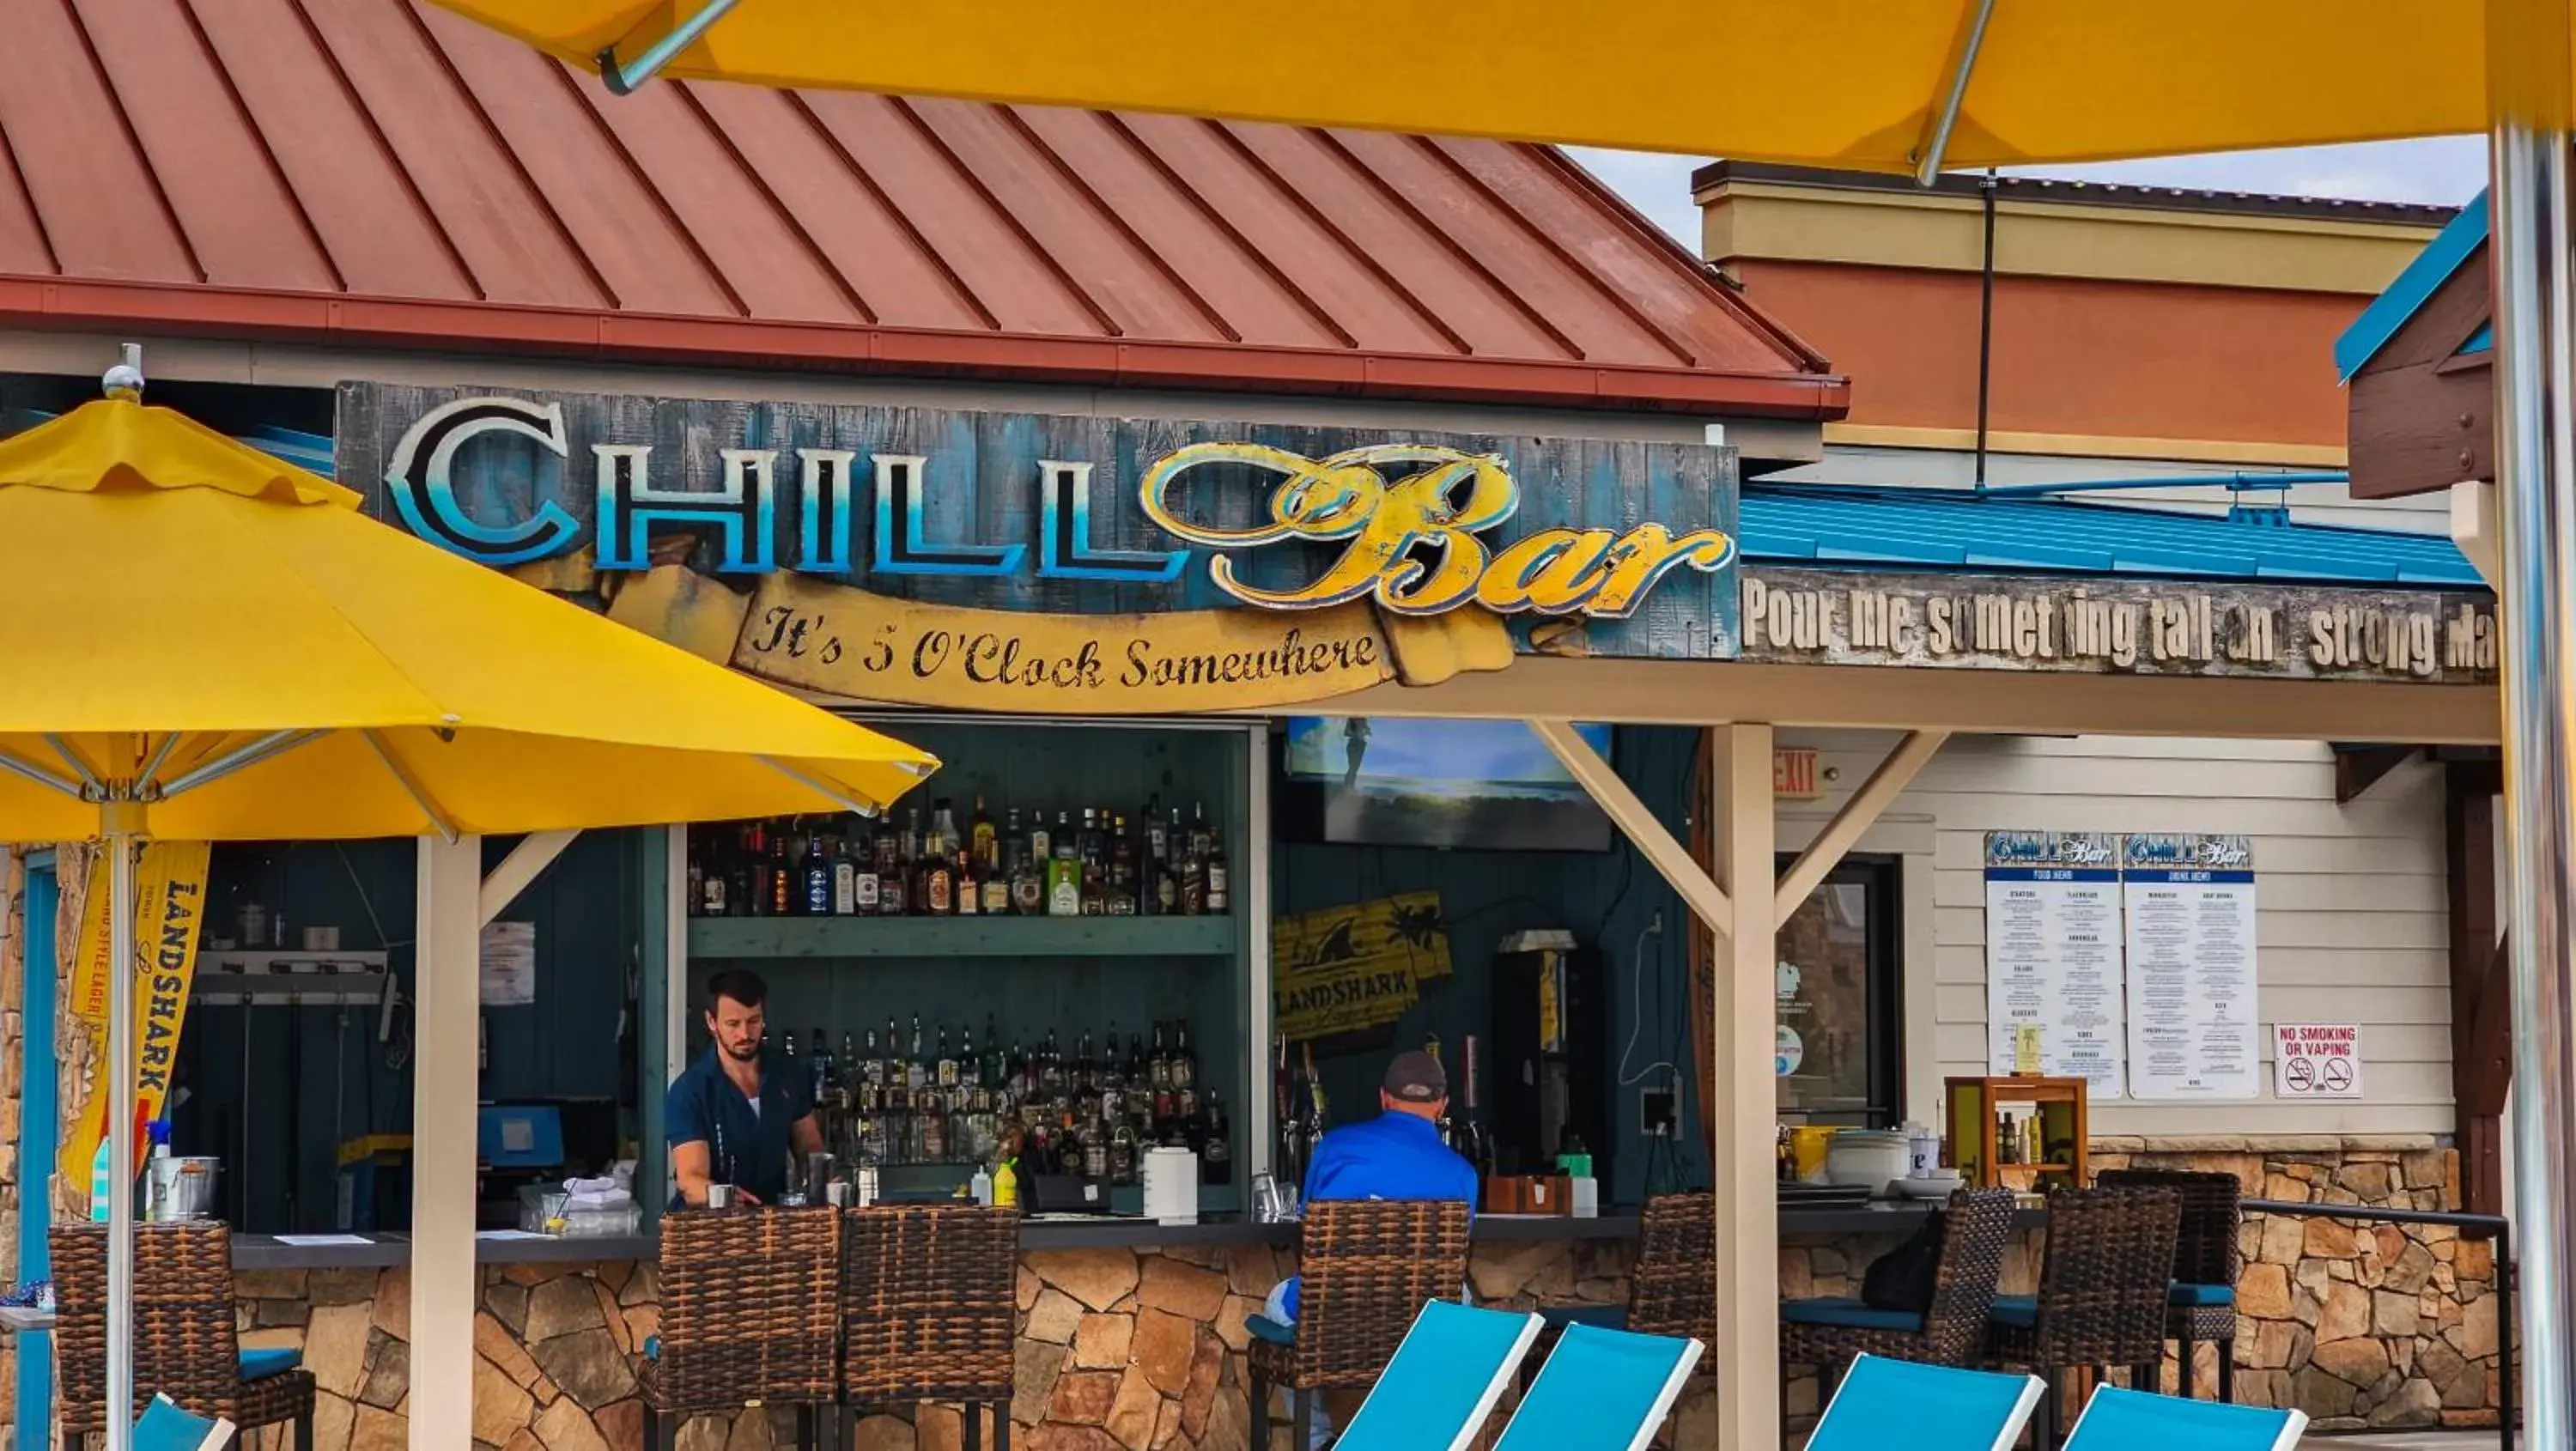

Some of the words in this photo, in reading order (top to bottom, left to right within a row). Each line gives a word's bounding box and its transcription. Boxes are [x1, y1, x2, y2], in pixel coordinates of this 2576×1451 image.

[384, 397, 1191, 582] CHILL
[1139, 441, 1736, 619] Bar
[752, 605, 842, 665] It's
[863, 624, 897, 671] 5
[912, 629, 1105, 689] O'Clock
[1120, 628, 1377, 688] Somewhere
[1742, 577, 1836, 649] Pour
[1850, 589, 1913, 655] me
[2150, 595, 2213, 661] tall
[2309, 604, 2436, 676] strong
[2447, 604, 2500, 670] Ma
[87, 973, 106, 1014] LAGER
[138, 880, 198, 1092] LANDSHARK
[2280, 1027, 2296, 1041] NO
[2300, 1027, 2355, 1041] SMOKING
[2285, 1041, 2302, 1056] OR
[2306, 1041, 2350, 1056] VAPING
